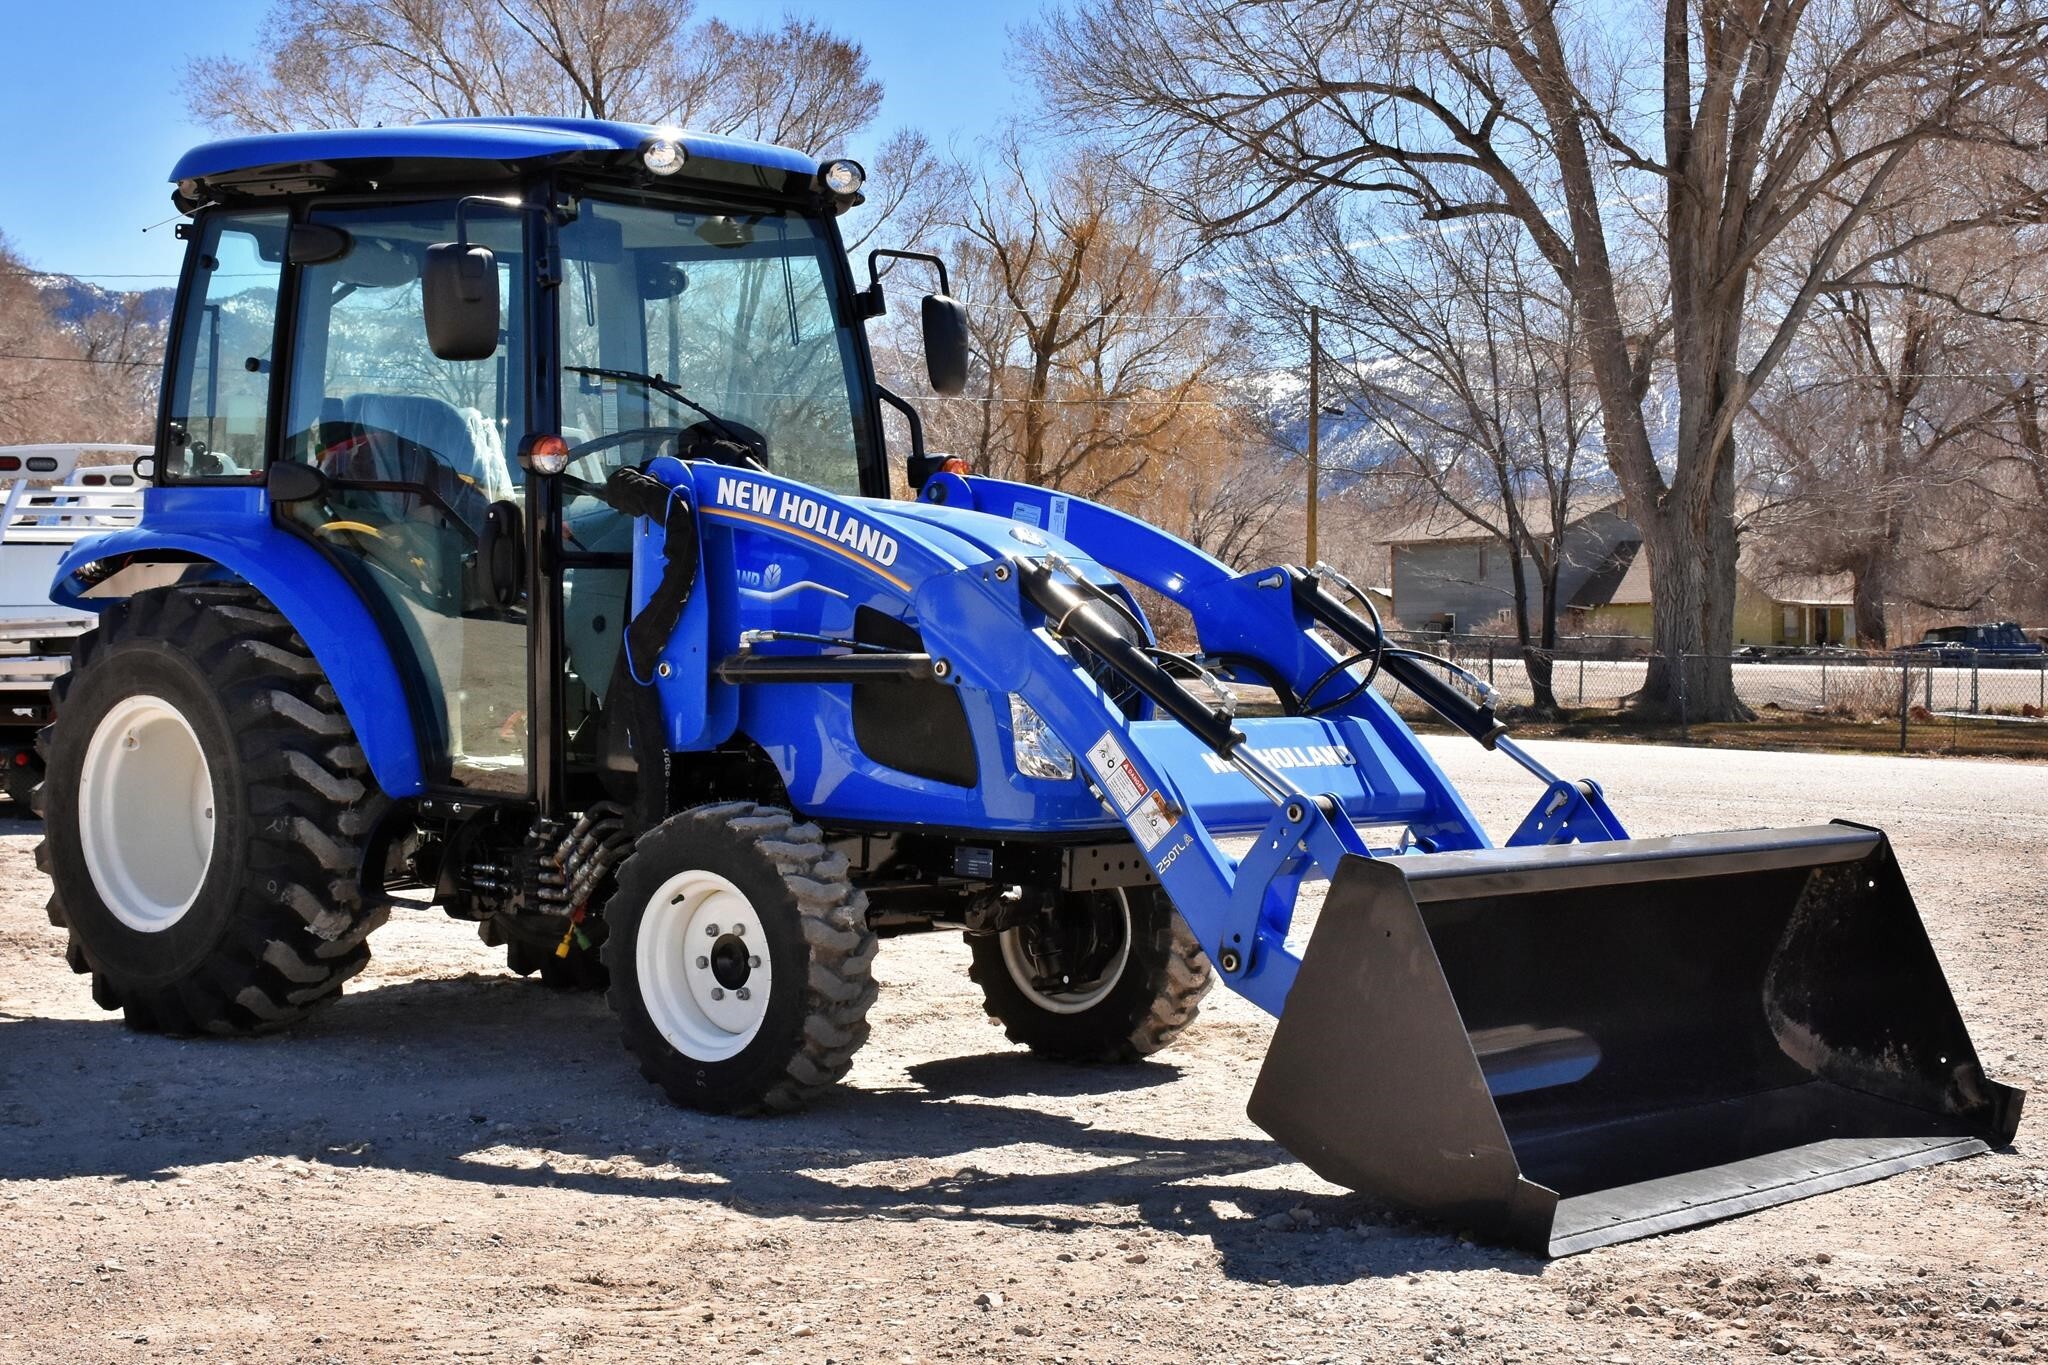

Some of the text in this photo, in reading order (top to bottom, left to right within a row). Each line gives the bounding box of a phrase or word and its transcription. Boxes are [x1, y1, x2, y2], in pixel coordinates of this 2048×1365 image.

[717, 477, 898, 567] NEW HOLLAND
[1250, 745, 1357, 769] HOLLAND
[1127, 768, 1146, 793] DANGER
